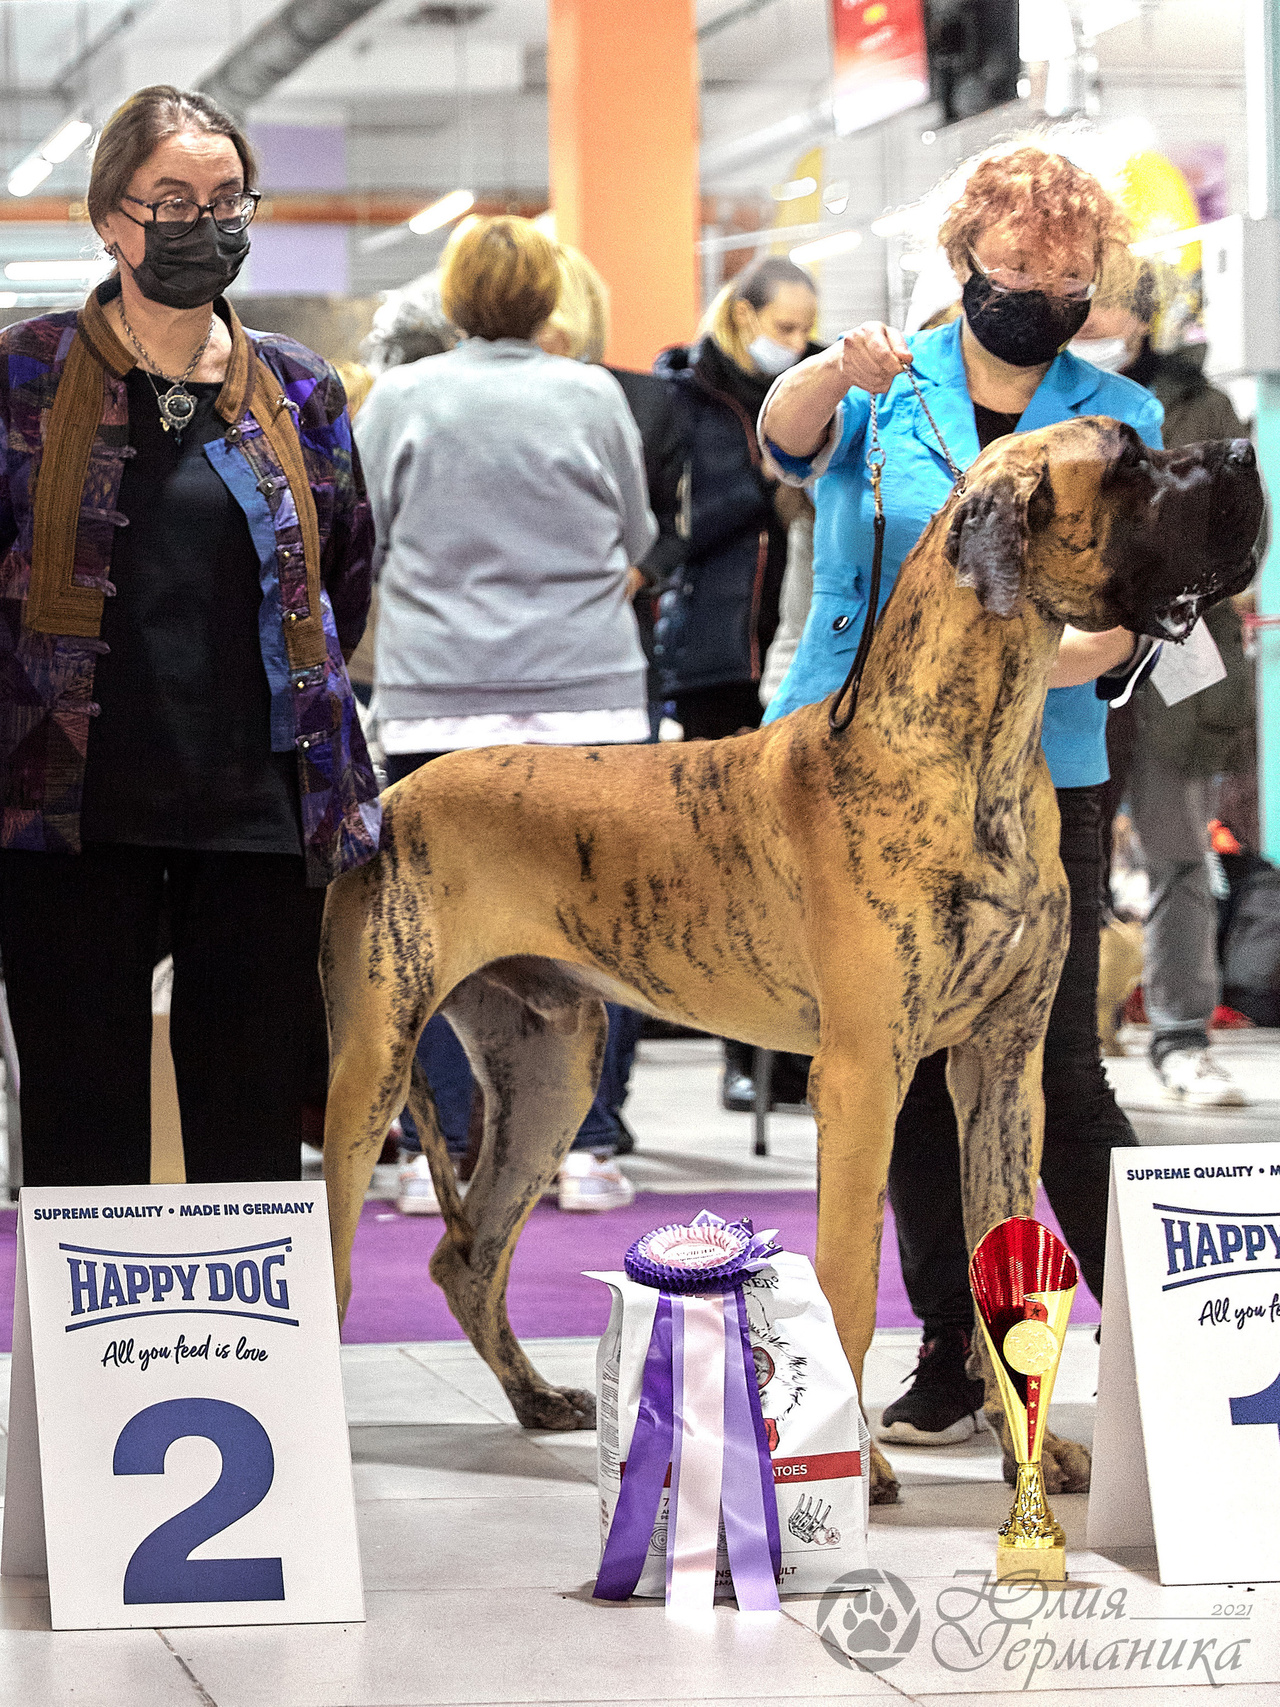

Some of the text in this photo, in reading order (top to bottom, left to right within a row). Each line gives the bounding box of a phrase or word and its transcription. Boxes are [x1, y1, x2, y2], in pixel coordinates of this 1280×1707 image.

[1126, 1167, 1192, 1181] SUPREME
[1193, 1165, 1254, 1179] QUALITY
[33, 1201, 315, 1221] SUPREME QUALITY MADE IN GERMANY
[66, 1256, 201, 1316] HAPPY
[1197, 1296, 1231, 1326] All
[1234, 1305, 1267, 1330] you
[100, 1334, 269, 1372] All you feed is love
[112, 1397, 287, 1606] 2
